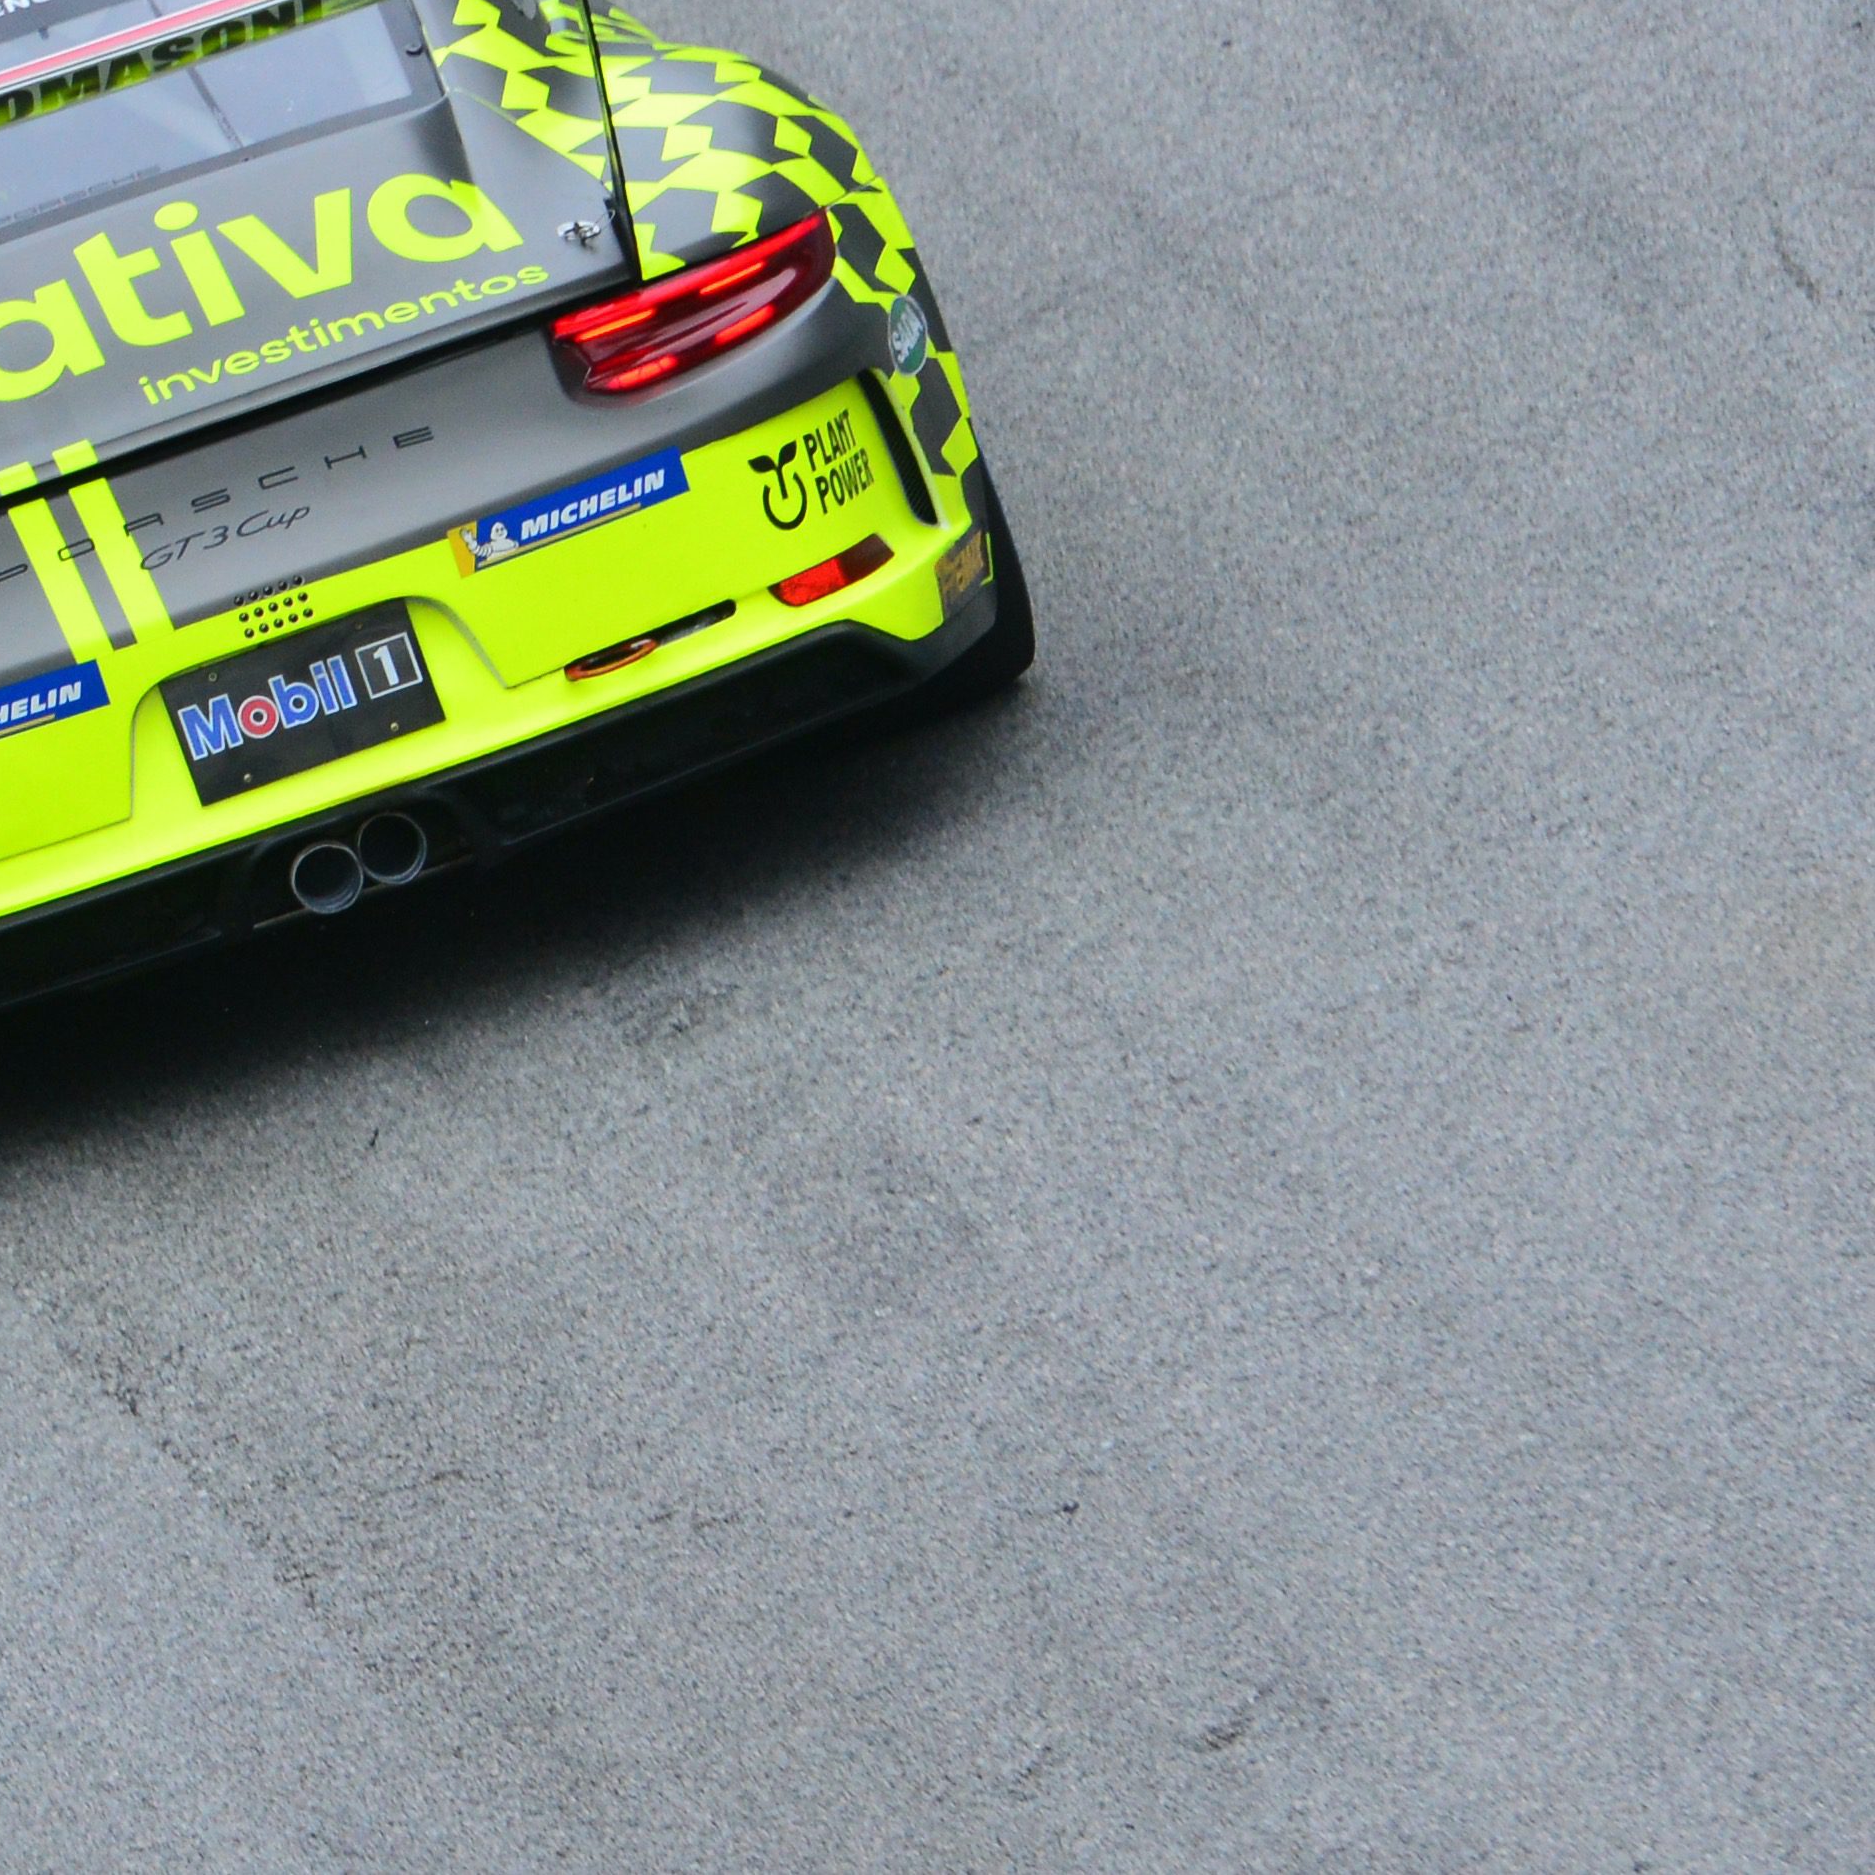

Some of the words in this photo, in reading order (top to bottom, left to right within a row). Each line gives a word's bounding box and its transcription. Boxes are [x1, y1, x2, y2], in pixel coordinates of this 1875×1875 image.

[138, 263, 550, 406] investimentos
[802, 409, 858, 472] PLANT
[520, 468, 666, 541] MICHELIN
[815, 448, 875, 514] POWER
[177, 654, 358, 761] Mobil
